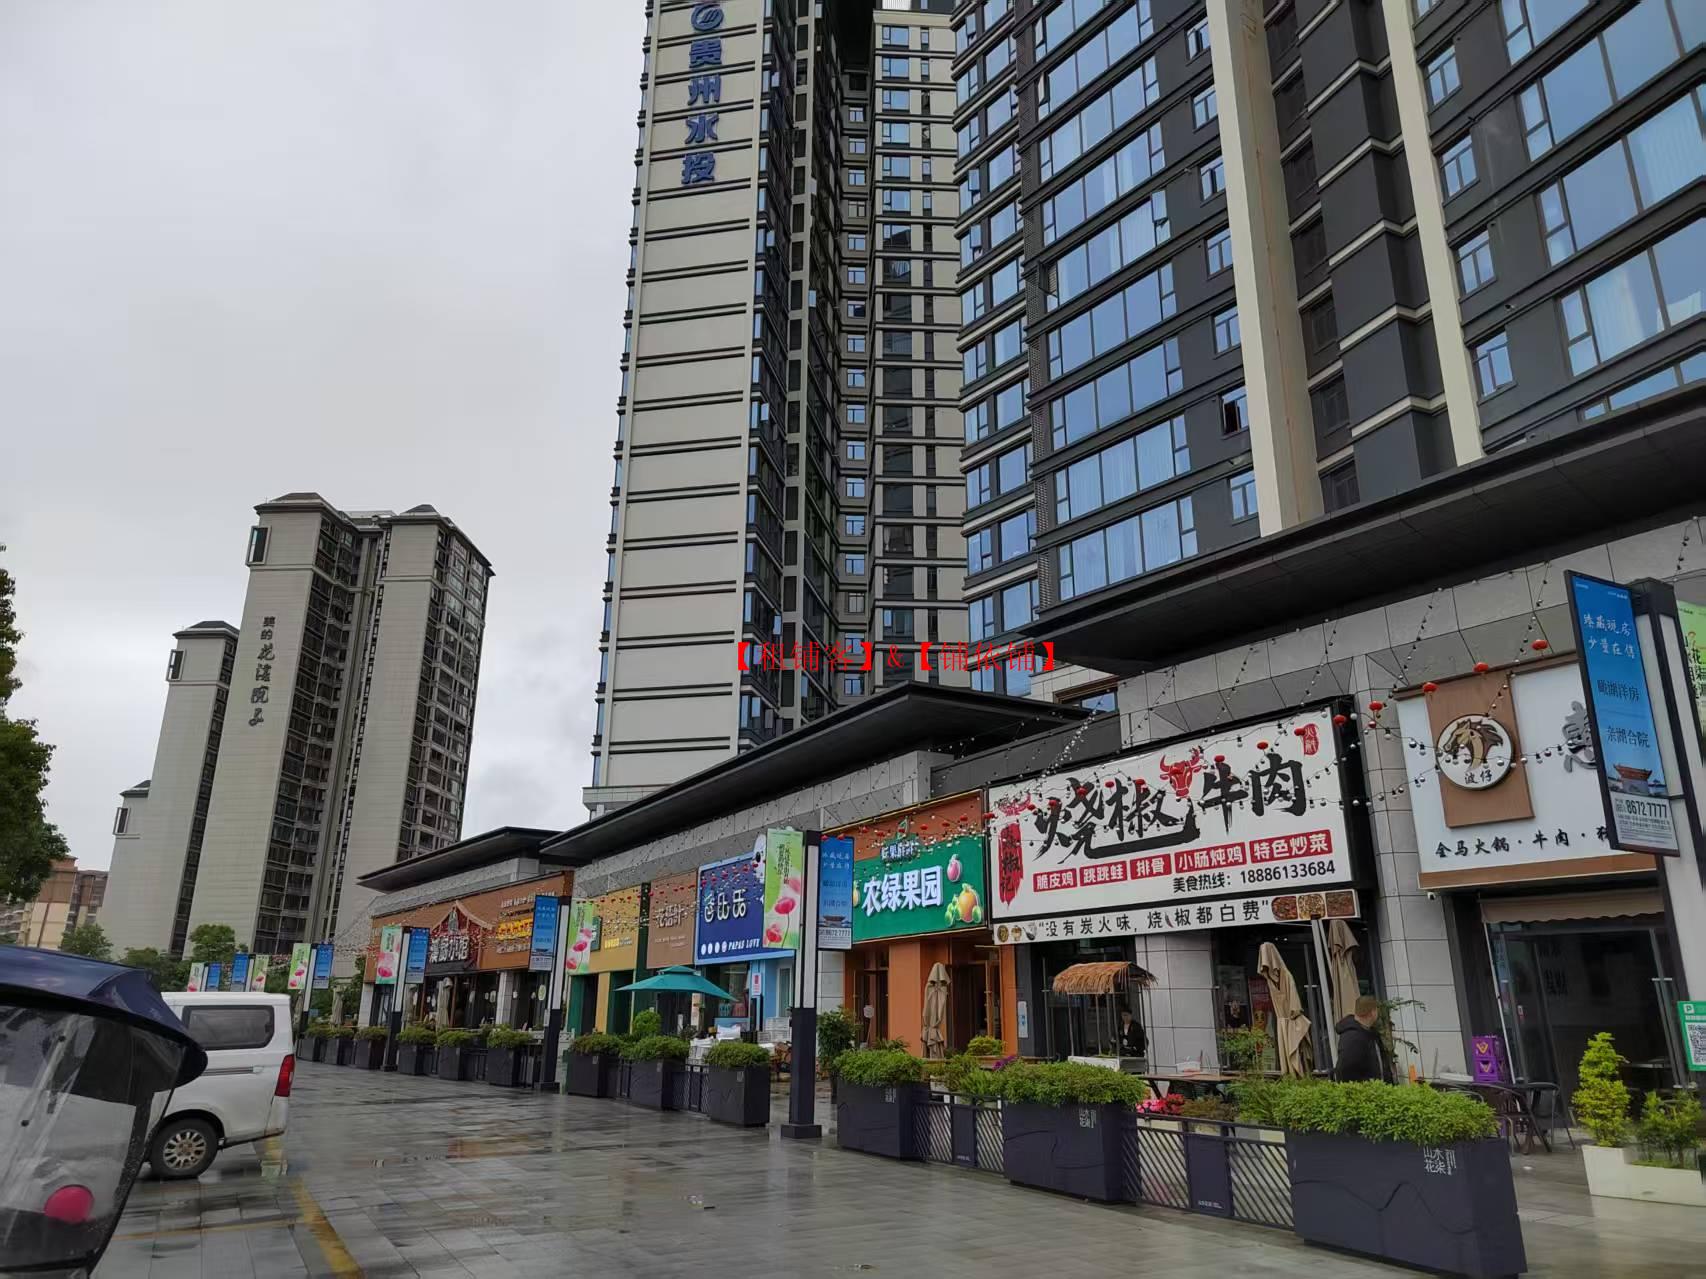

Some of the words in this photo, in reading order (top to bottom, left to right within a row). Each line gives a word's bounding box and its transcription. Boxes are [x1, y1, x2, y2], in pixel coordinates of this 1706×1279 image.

[681, 37, 722, 185] 贵州水投
[1033, 753, 1307, 864] 烧椒牛肉
[1036, 871, 1074, 891] 脆皮鸡
[1083, 864, 1125, 884] 跳跳蛙
[1135, 859, 1167, 876] 排骨
[1178, 846, 1244, 870] 小肠炖鸡
[1253, 833, 1329, 862] 特色炒菜
[1240, 860, 1336, 885] 18886133684
[862, 866, 943, 917] 农绿果园
